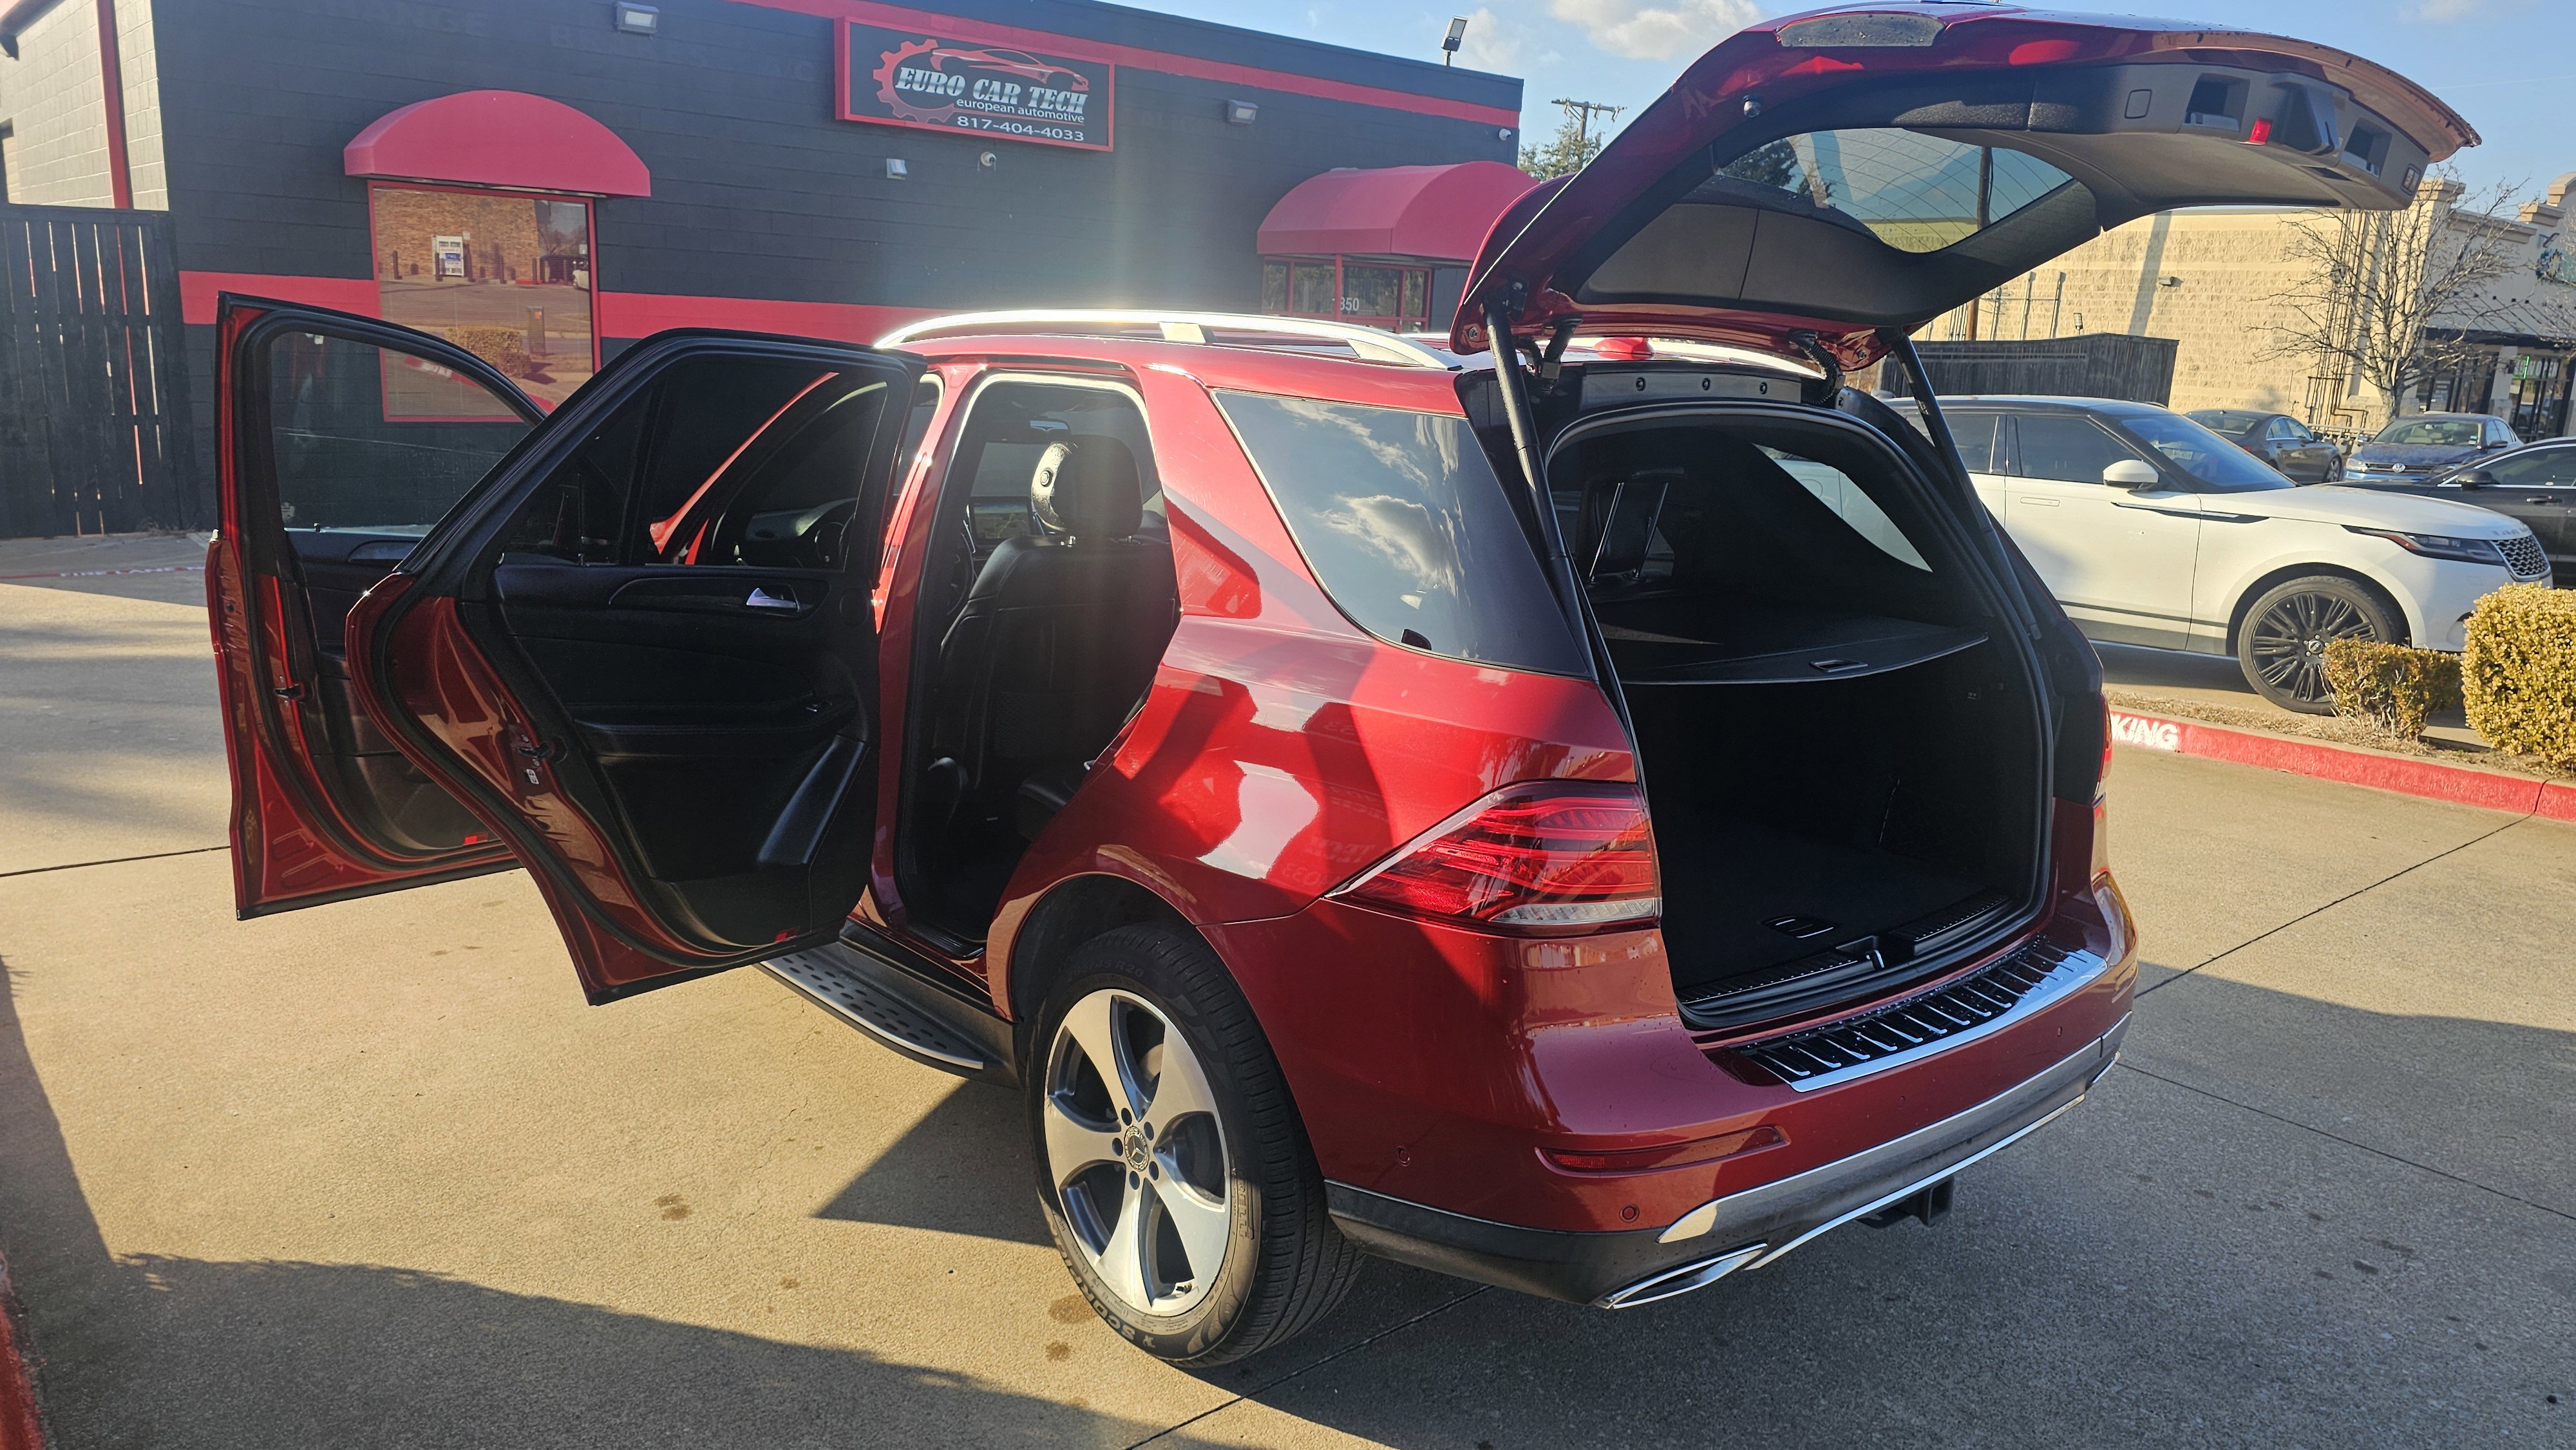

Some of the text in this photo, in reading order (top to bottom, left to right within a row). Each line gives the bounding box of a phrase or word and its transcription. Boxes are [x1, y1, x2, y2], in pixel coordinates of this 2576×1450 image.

[895, 67, 1088, 114] EURO CAR TECH
[956, 99, 1084, 123] european automotive
[957, 116, 1084, 141] 817-404-4033
[2111, 714, 2178, 750] KING
